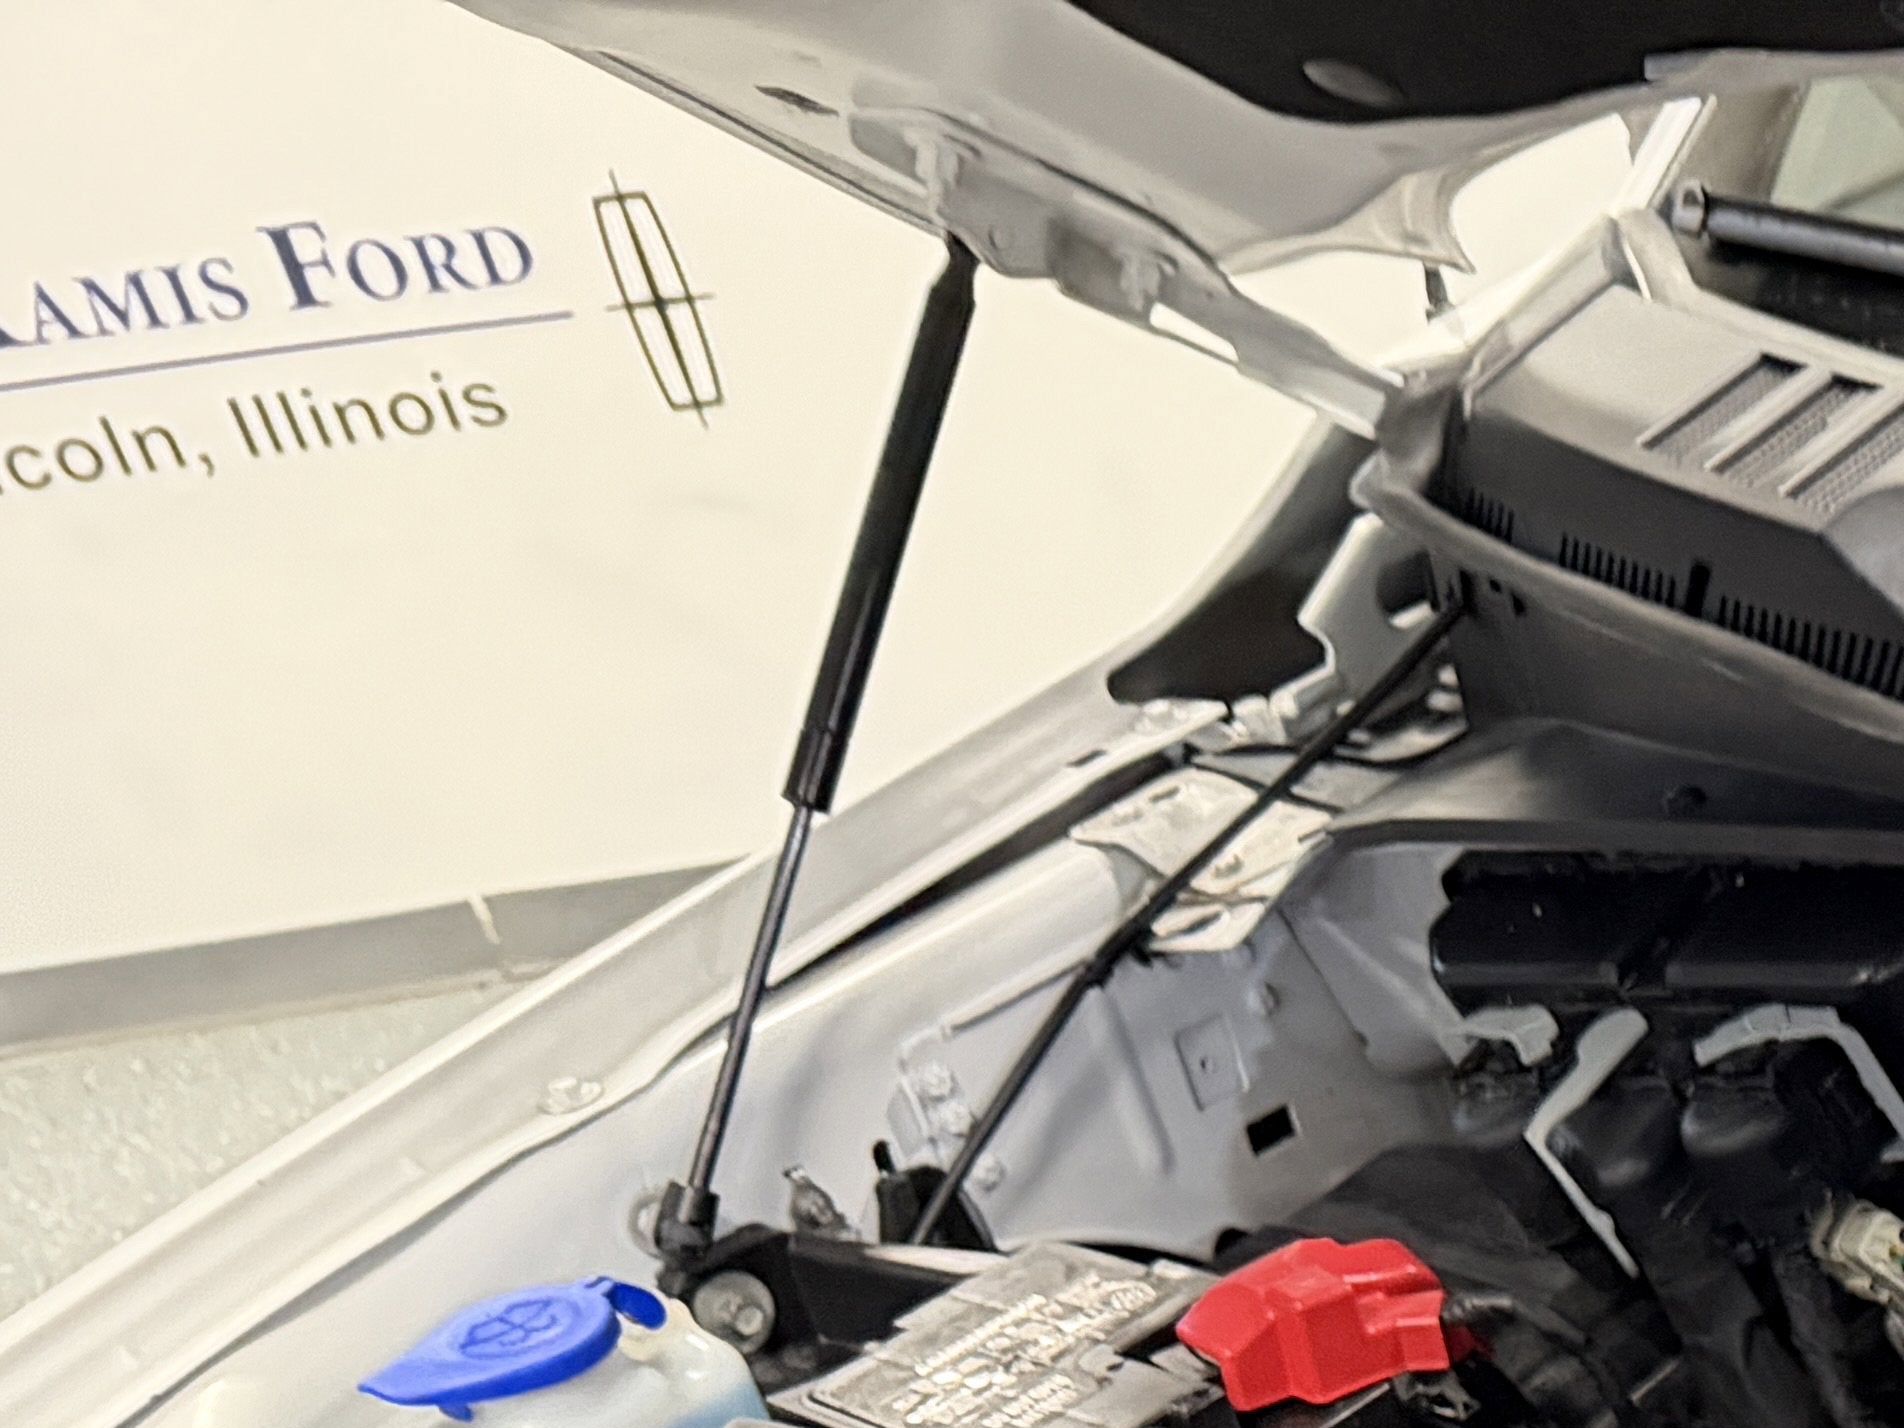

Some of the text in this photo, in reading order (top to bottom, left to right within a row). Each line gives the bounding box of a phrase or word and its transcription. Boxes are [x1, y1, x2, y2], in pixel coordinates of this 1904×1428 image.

[0, 220, 534, 346] AMIS FORD
[0, 372, 508, 491] coln, Illinois
